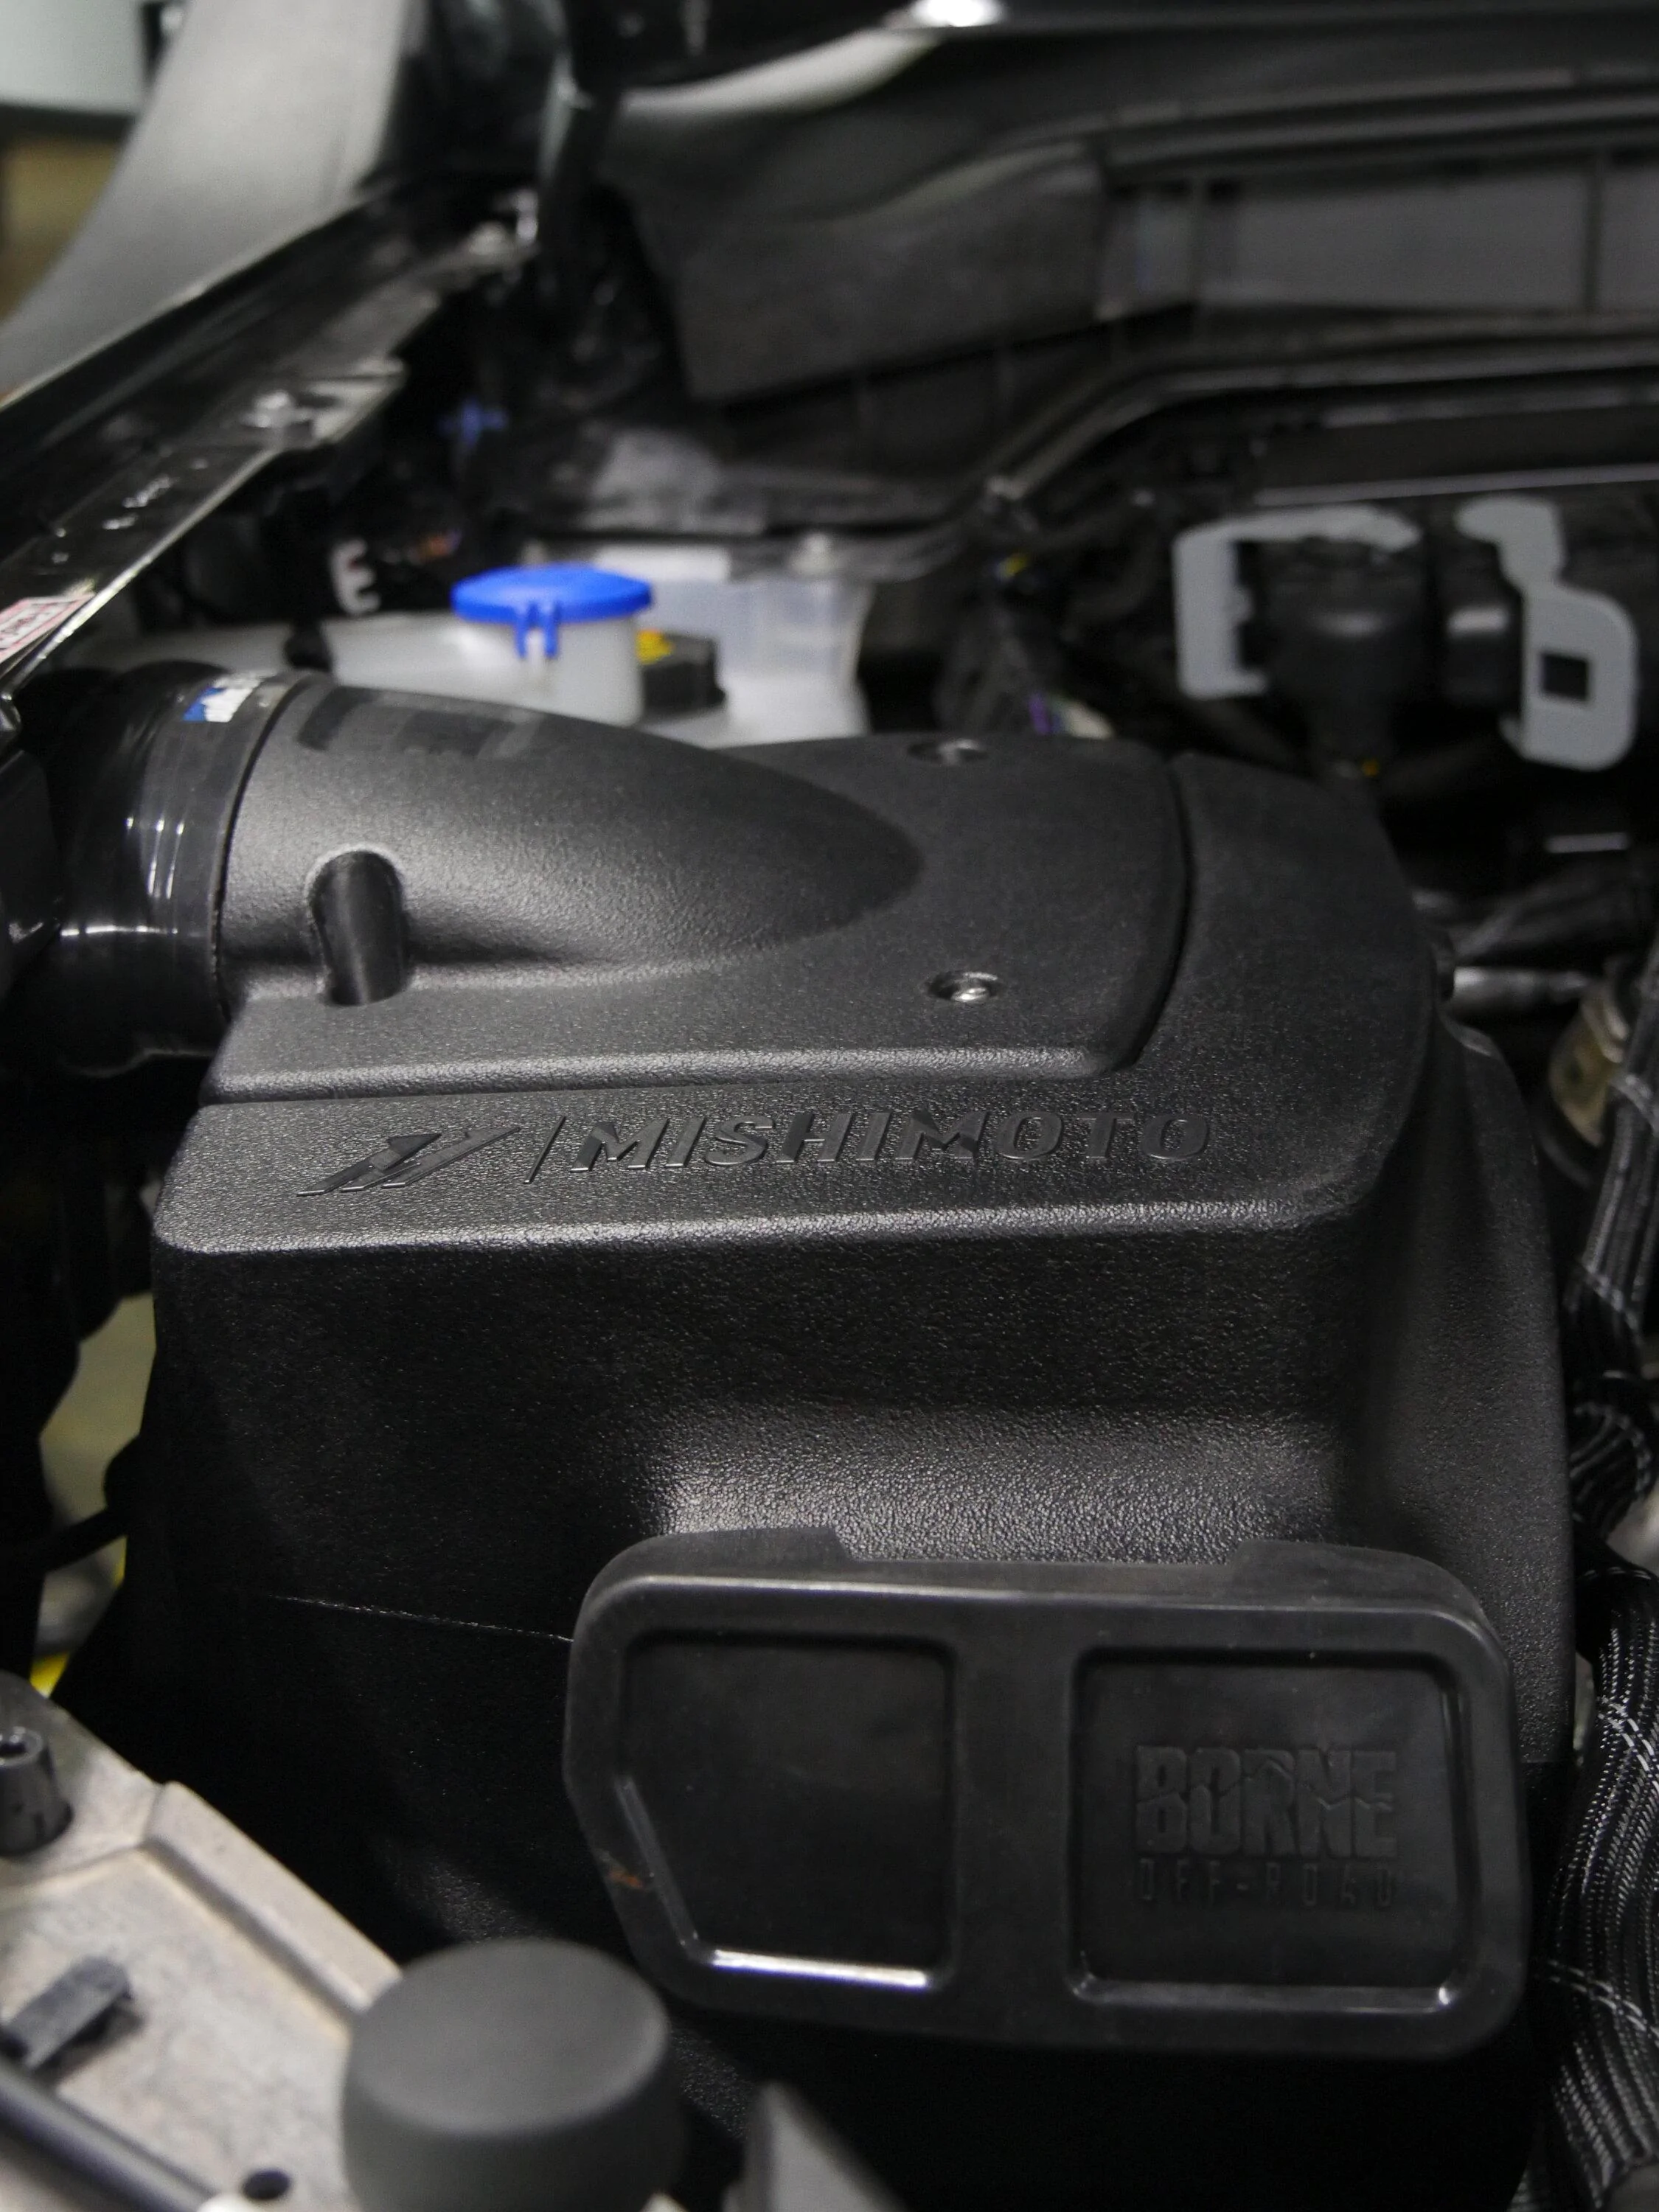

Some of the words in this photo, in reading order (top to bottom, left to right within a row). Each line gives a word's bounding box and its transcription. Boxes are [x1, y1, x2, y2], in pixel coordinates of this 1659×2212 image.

[570, 1110, 1213, 1173] MISHIMOTO
[1135, 1745, 1398, 1858] BORNE
[1138, 1857, 1395, 1908] OFF-ROAD
